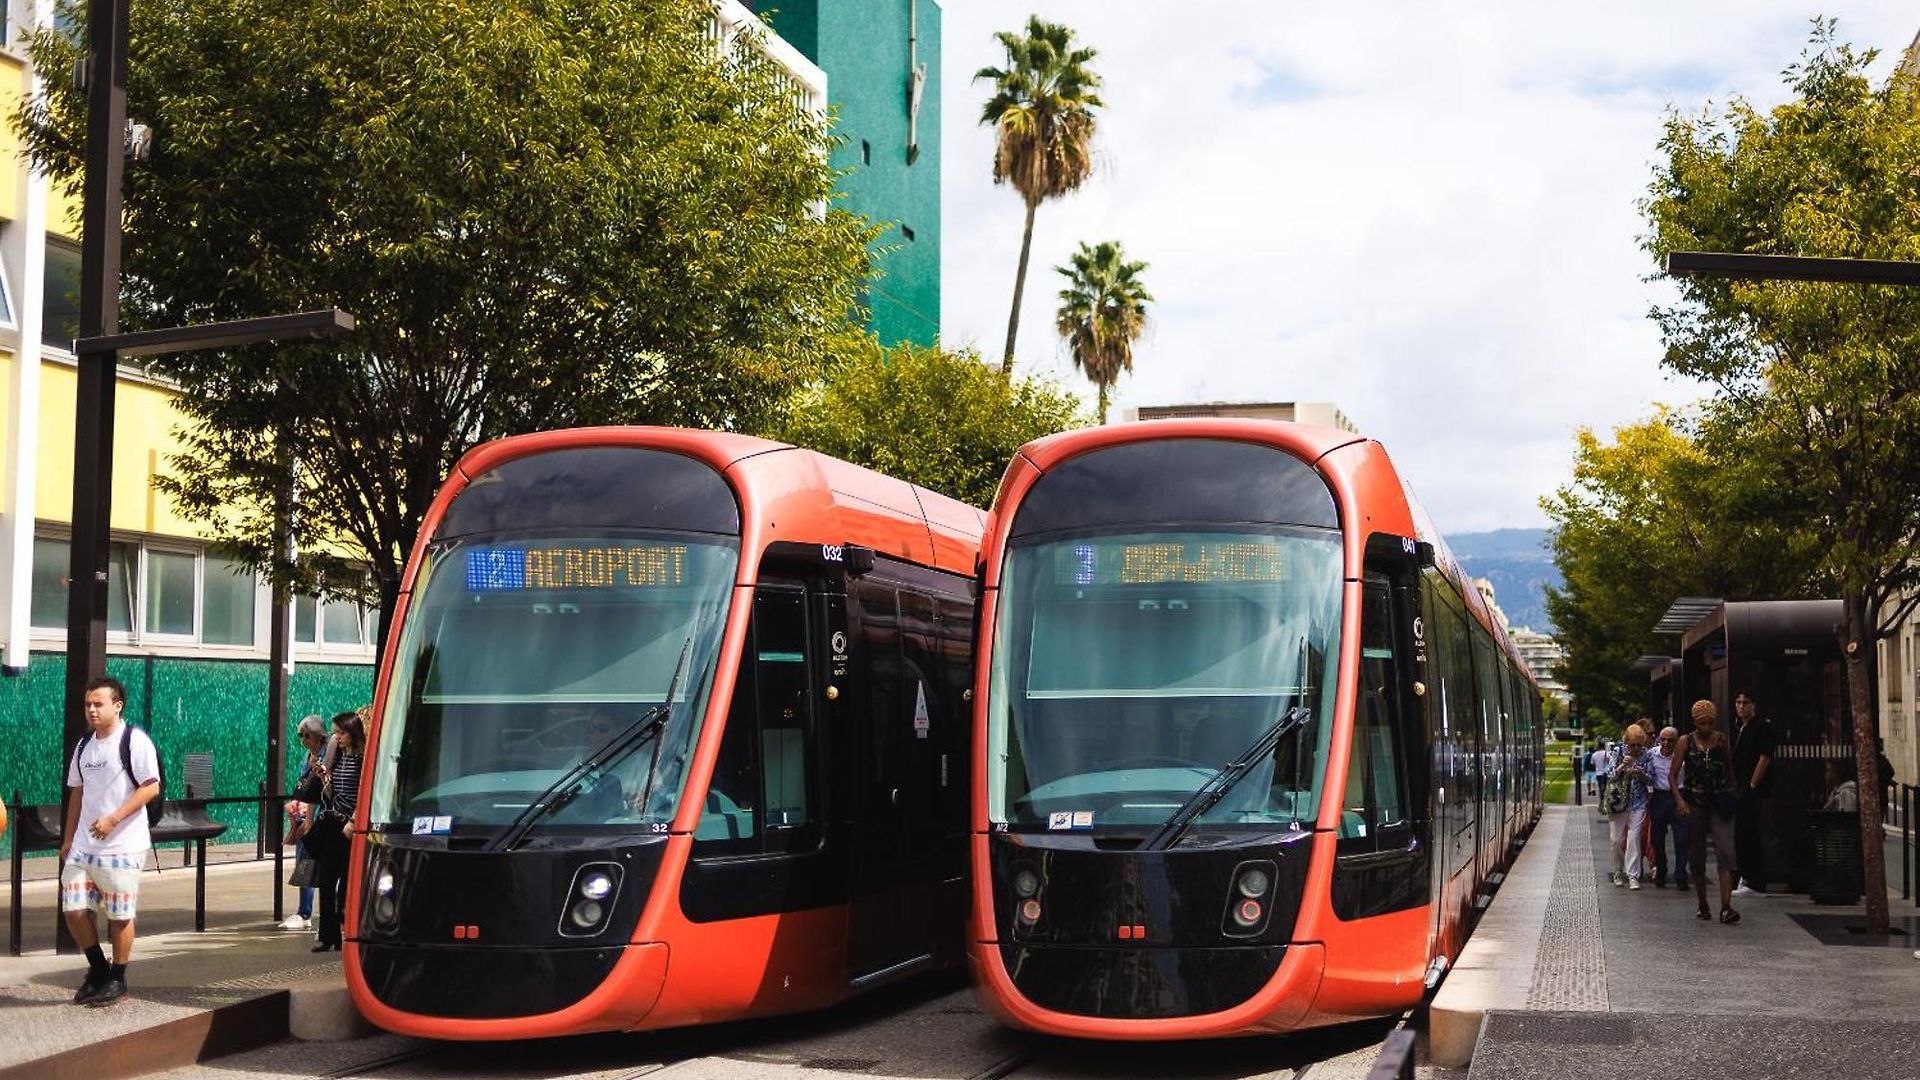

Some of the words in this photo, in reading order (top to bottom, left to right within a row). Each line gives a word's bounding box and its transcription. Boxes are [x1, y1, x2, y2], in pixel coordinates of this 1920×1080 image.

[822, 544, 843, 562] 032
[1402, 536, 1416, 555] 041
[524, 546, 688, 589] AEROPORT
[652, 823, 668, 833] 32
[1289, 821, 1300, 831] 41
